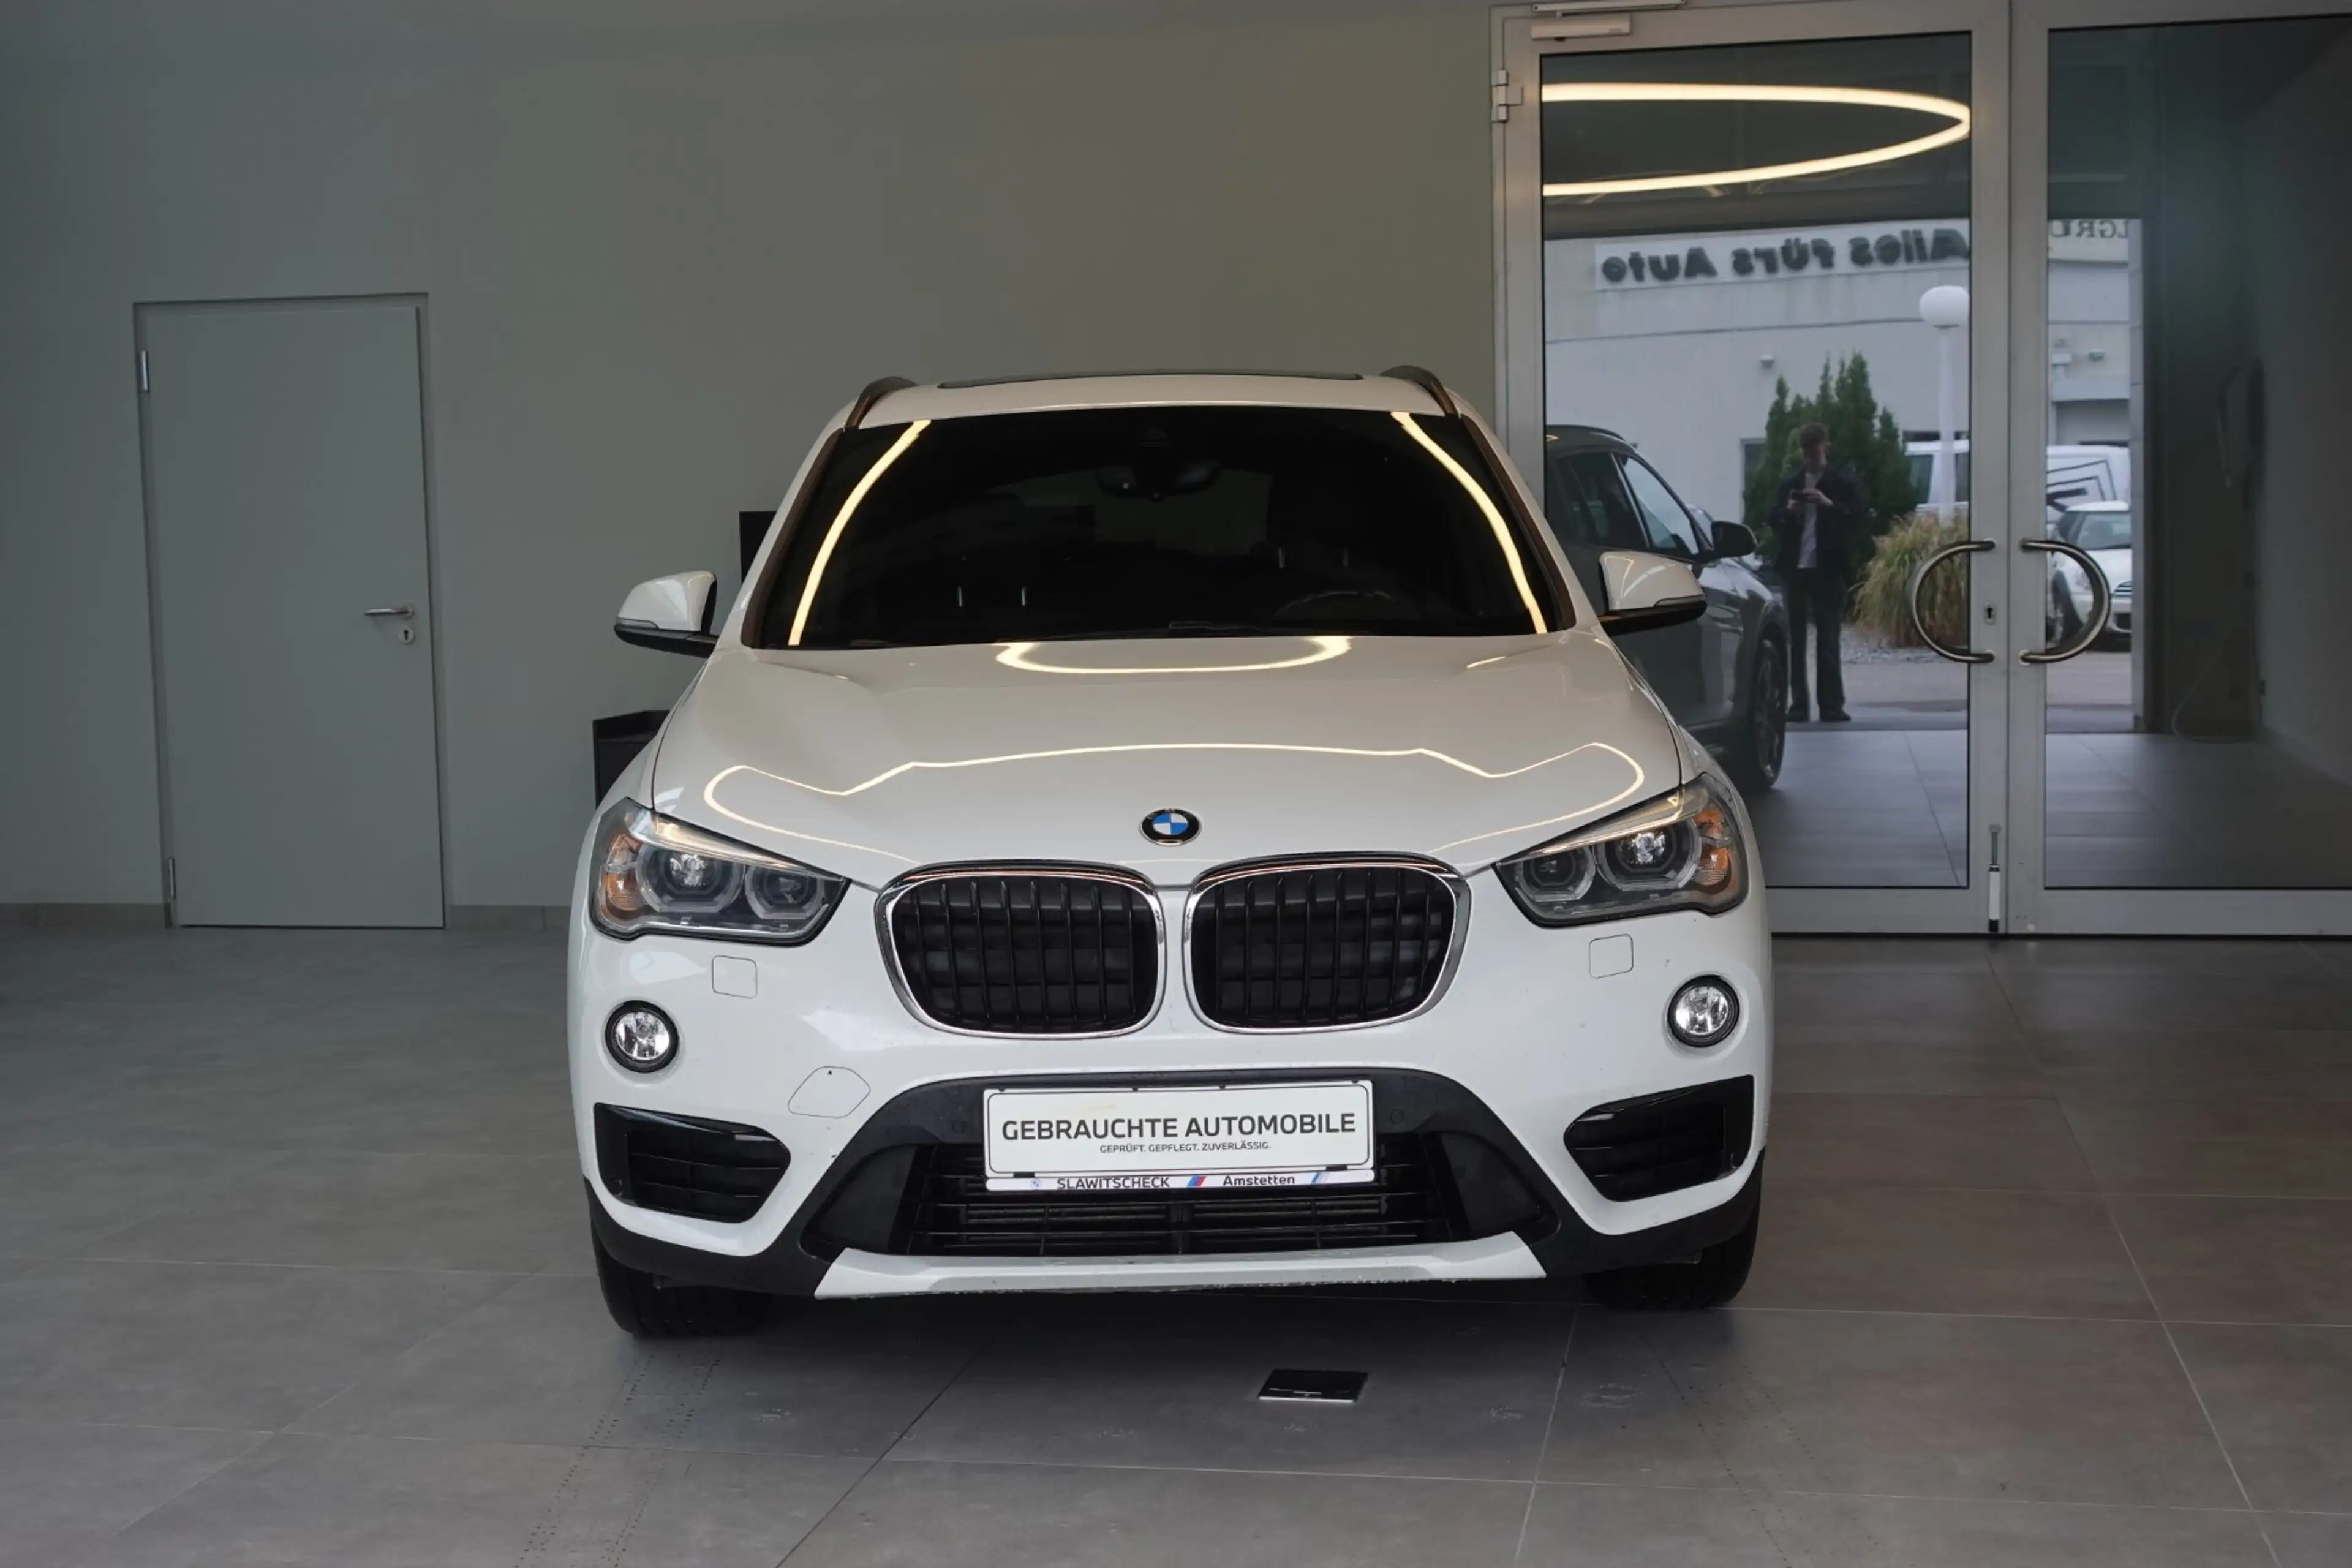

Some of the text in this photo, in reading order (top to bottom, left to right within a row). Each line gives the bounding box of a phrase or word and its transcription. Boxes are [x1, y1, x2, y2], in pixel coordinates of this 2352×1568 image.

[1001, 1113, 1356, 1140] GEBRAUCHTE AUTOMOBILE
[1099, 1140, 1272, 1153] GEPRÜFT. GEPFLEGT. ZUVERLÄSSIG.
[1056, 1174, 1295, 1189] SLAWITSCHECK Amstetten
